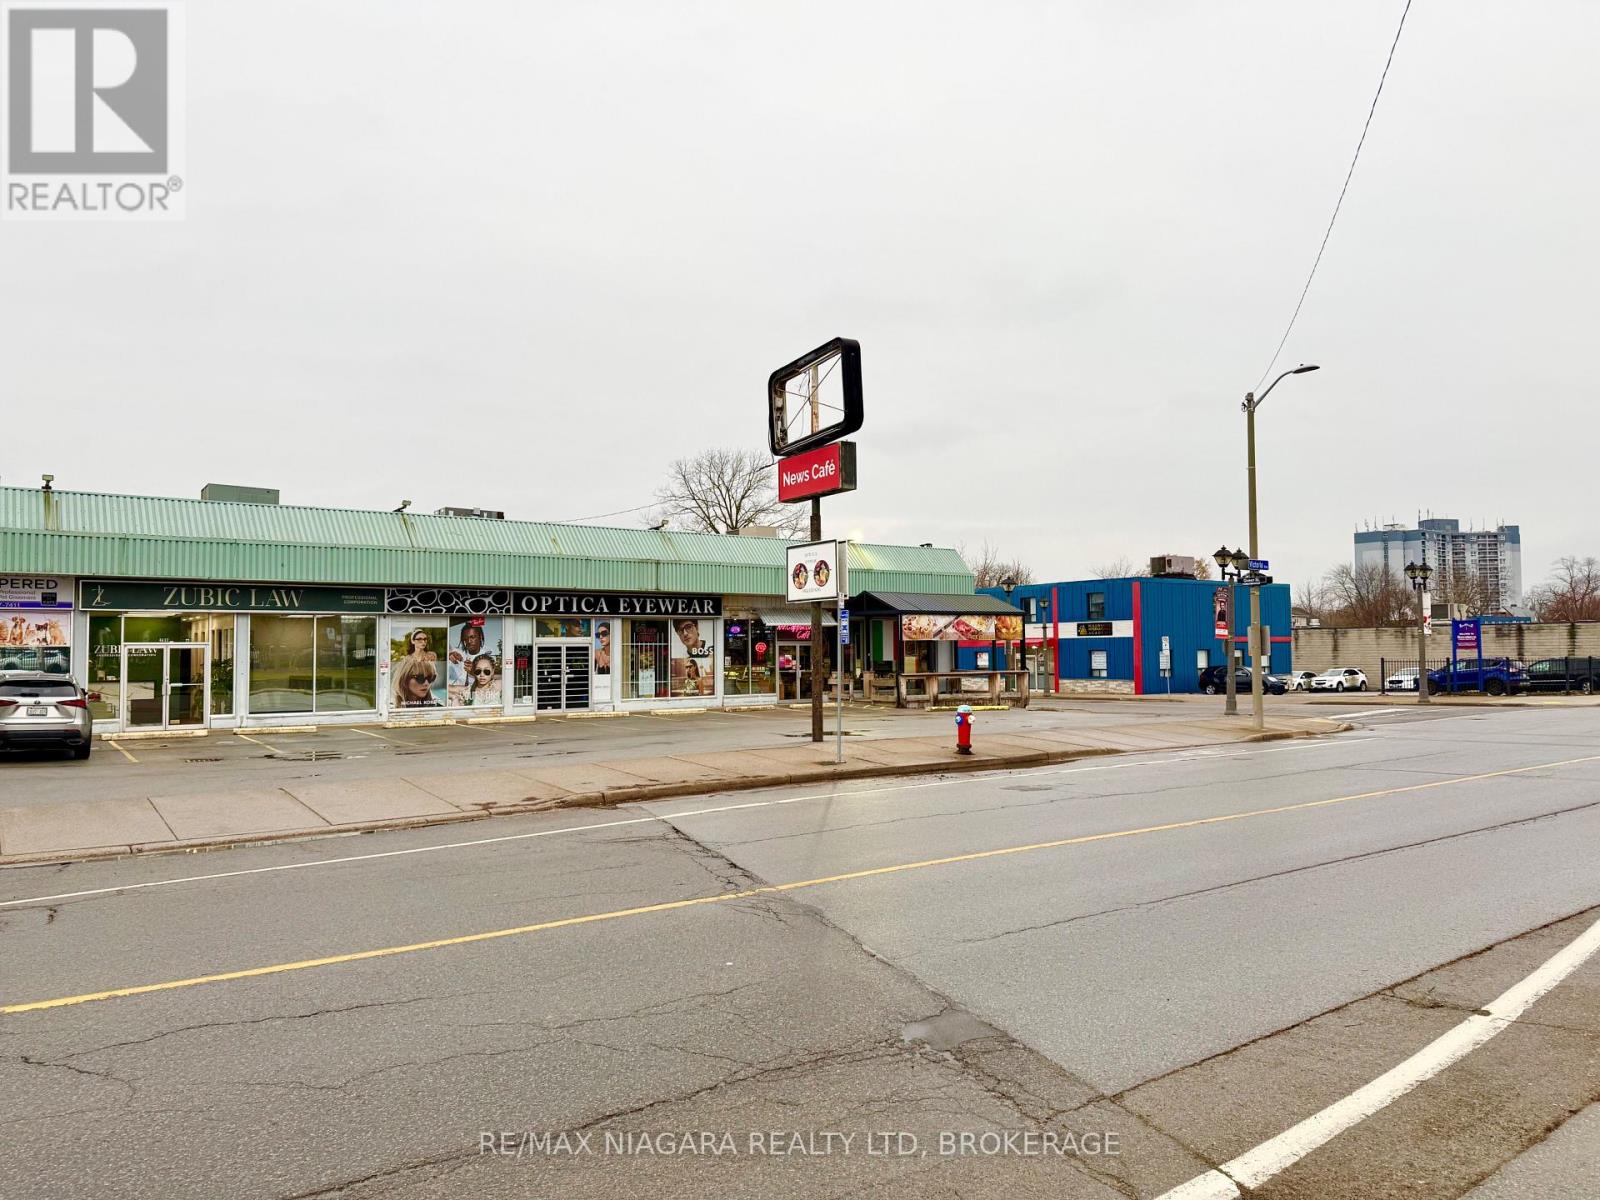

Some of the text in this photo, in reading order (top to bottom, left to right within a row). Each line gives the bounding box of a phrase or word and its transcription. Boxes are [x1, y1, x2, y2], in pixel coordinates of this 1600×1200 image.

[783, 459, 836, 487] News Café
[163, 586, 303, 608] ZUBIC LAW
[521, 595, 715, 614] OPTICA EYEWEAR
[94, 645, 122, 654] ZUBI
[691, 647, 714, 655] BOSS
